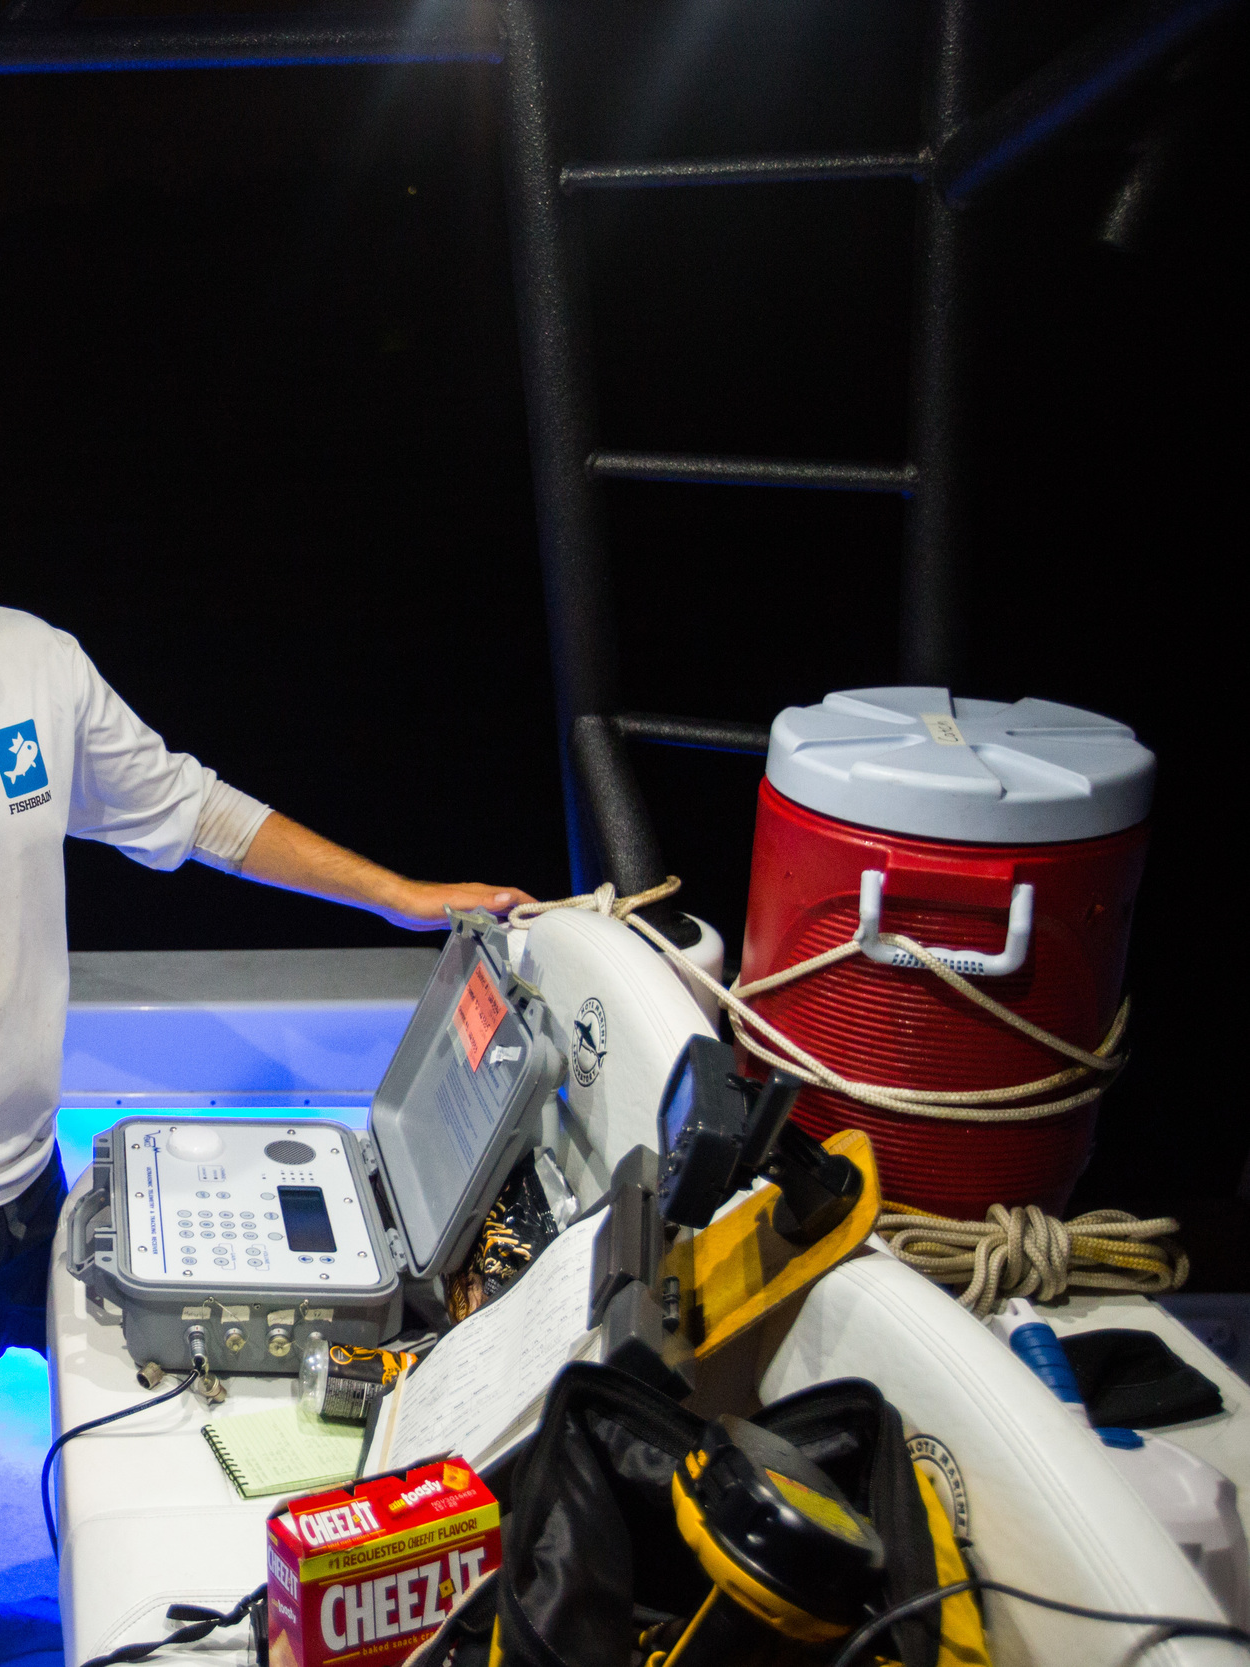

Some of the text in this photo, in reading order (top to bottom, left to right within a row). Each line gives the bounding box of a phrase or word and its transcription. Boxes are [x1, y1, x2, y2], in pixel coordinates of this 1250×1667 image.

[9, 790, 52, 815] FISHBRAIN
[403, 1479, 443, 1506] toasty
[329, 1558, 340, 1569] #1
[343, 1542, 406, 1569] REQUESTED
[438, 1518, 477, 1539] FLAVOR!
[362, 1642, 389, 1656] baked
[392, 1636, 418, 1648] snack
